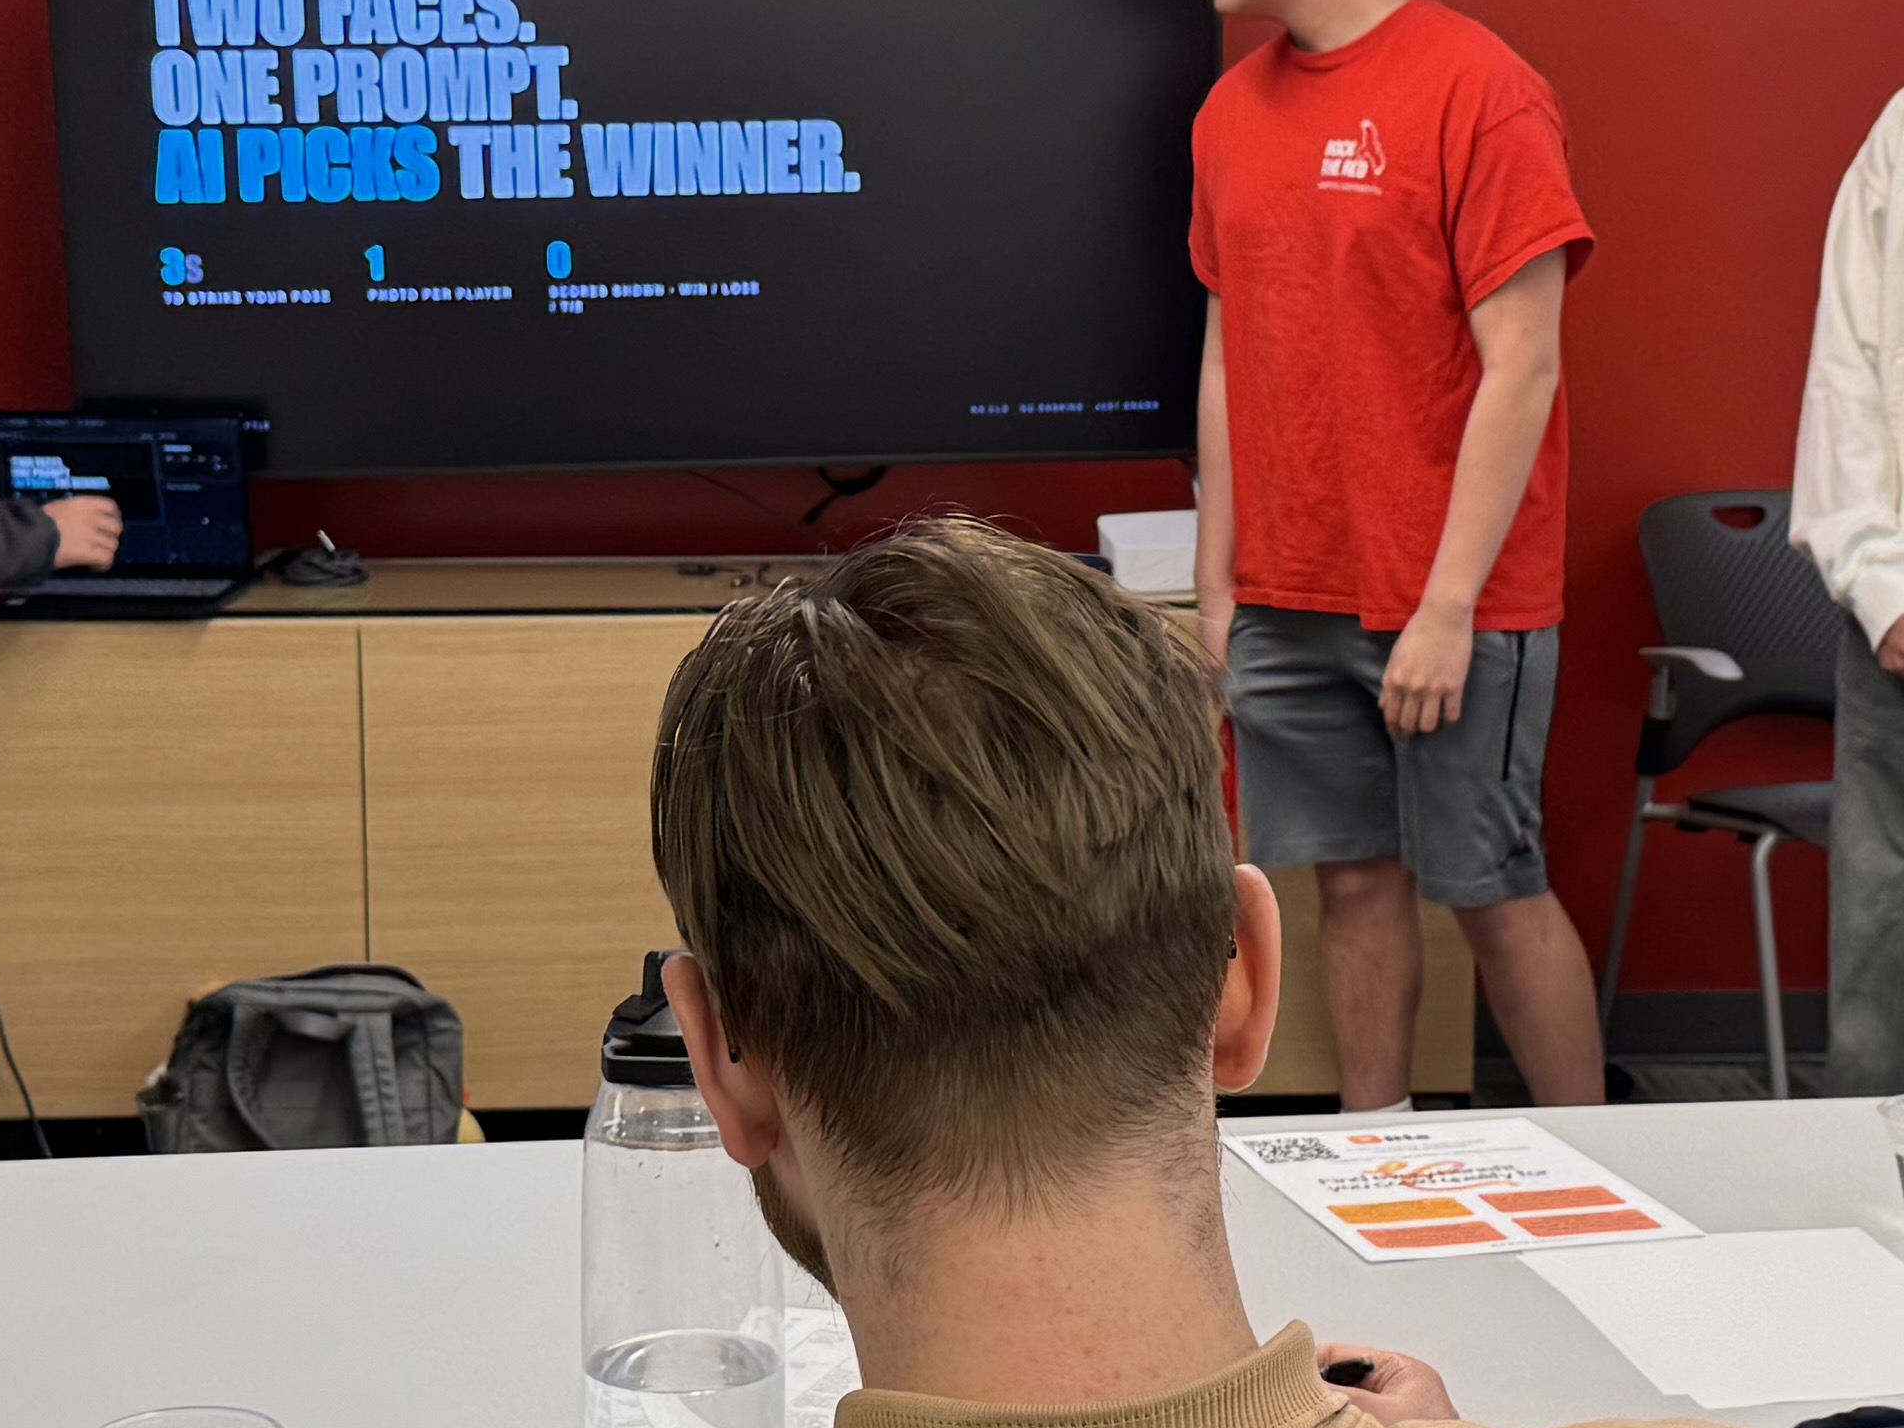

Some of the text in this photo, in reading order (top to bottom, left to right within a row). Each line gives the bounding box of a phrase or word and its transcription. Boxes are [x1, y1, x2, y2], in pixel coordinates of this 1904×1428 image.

[150, 44, 579, 126] ONE PROMPT.
[155, 119, 862, 204] AI PICKS THE WINNER.
[364, 244, 385, 282] 1
[546, 240, 572, 280] 0
